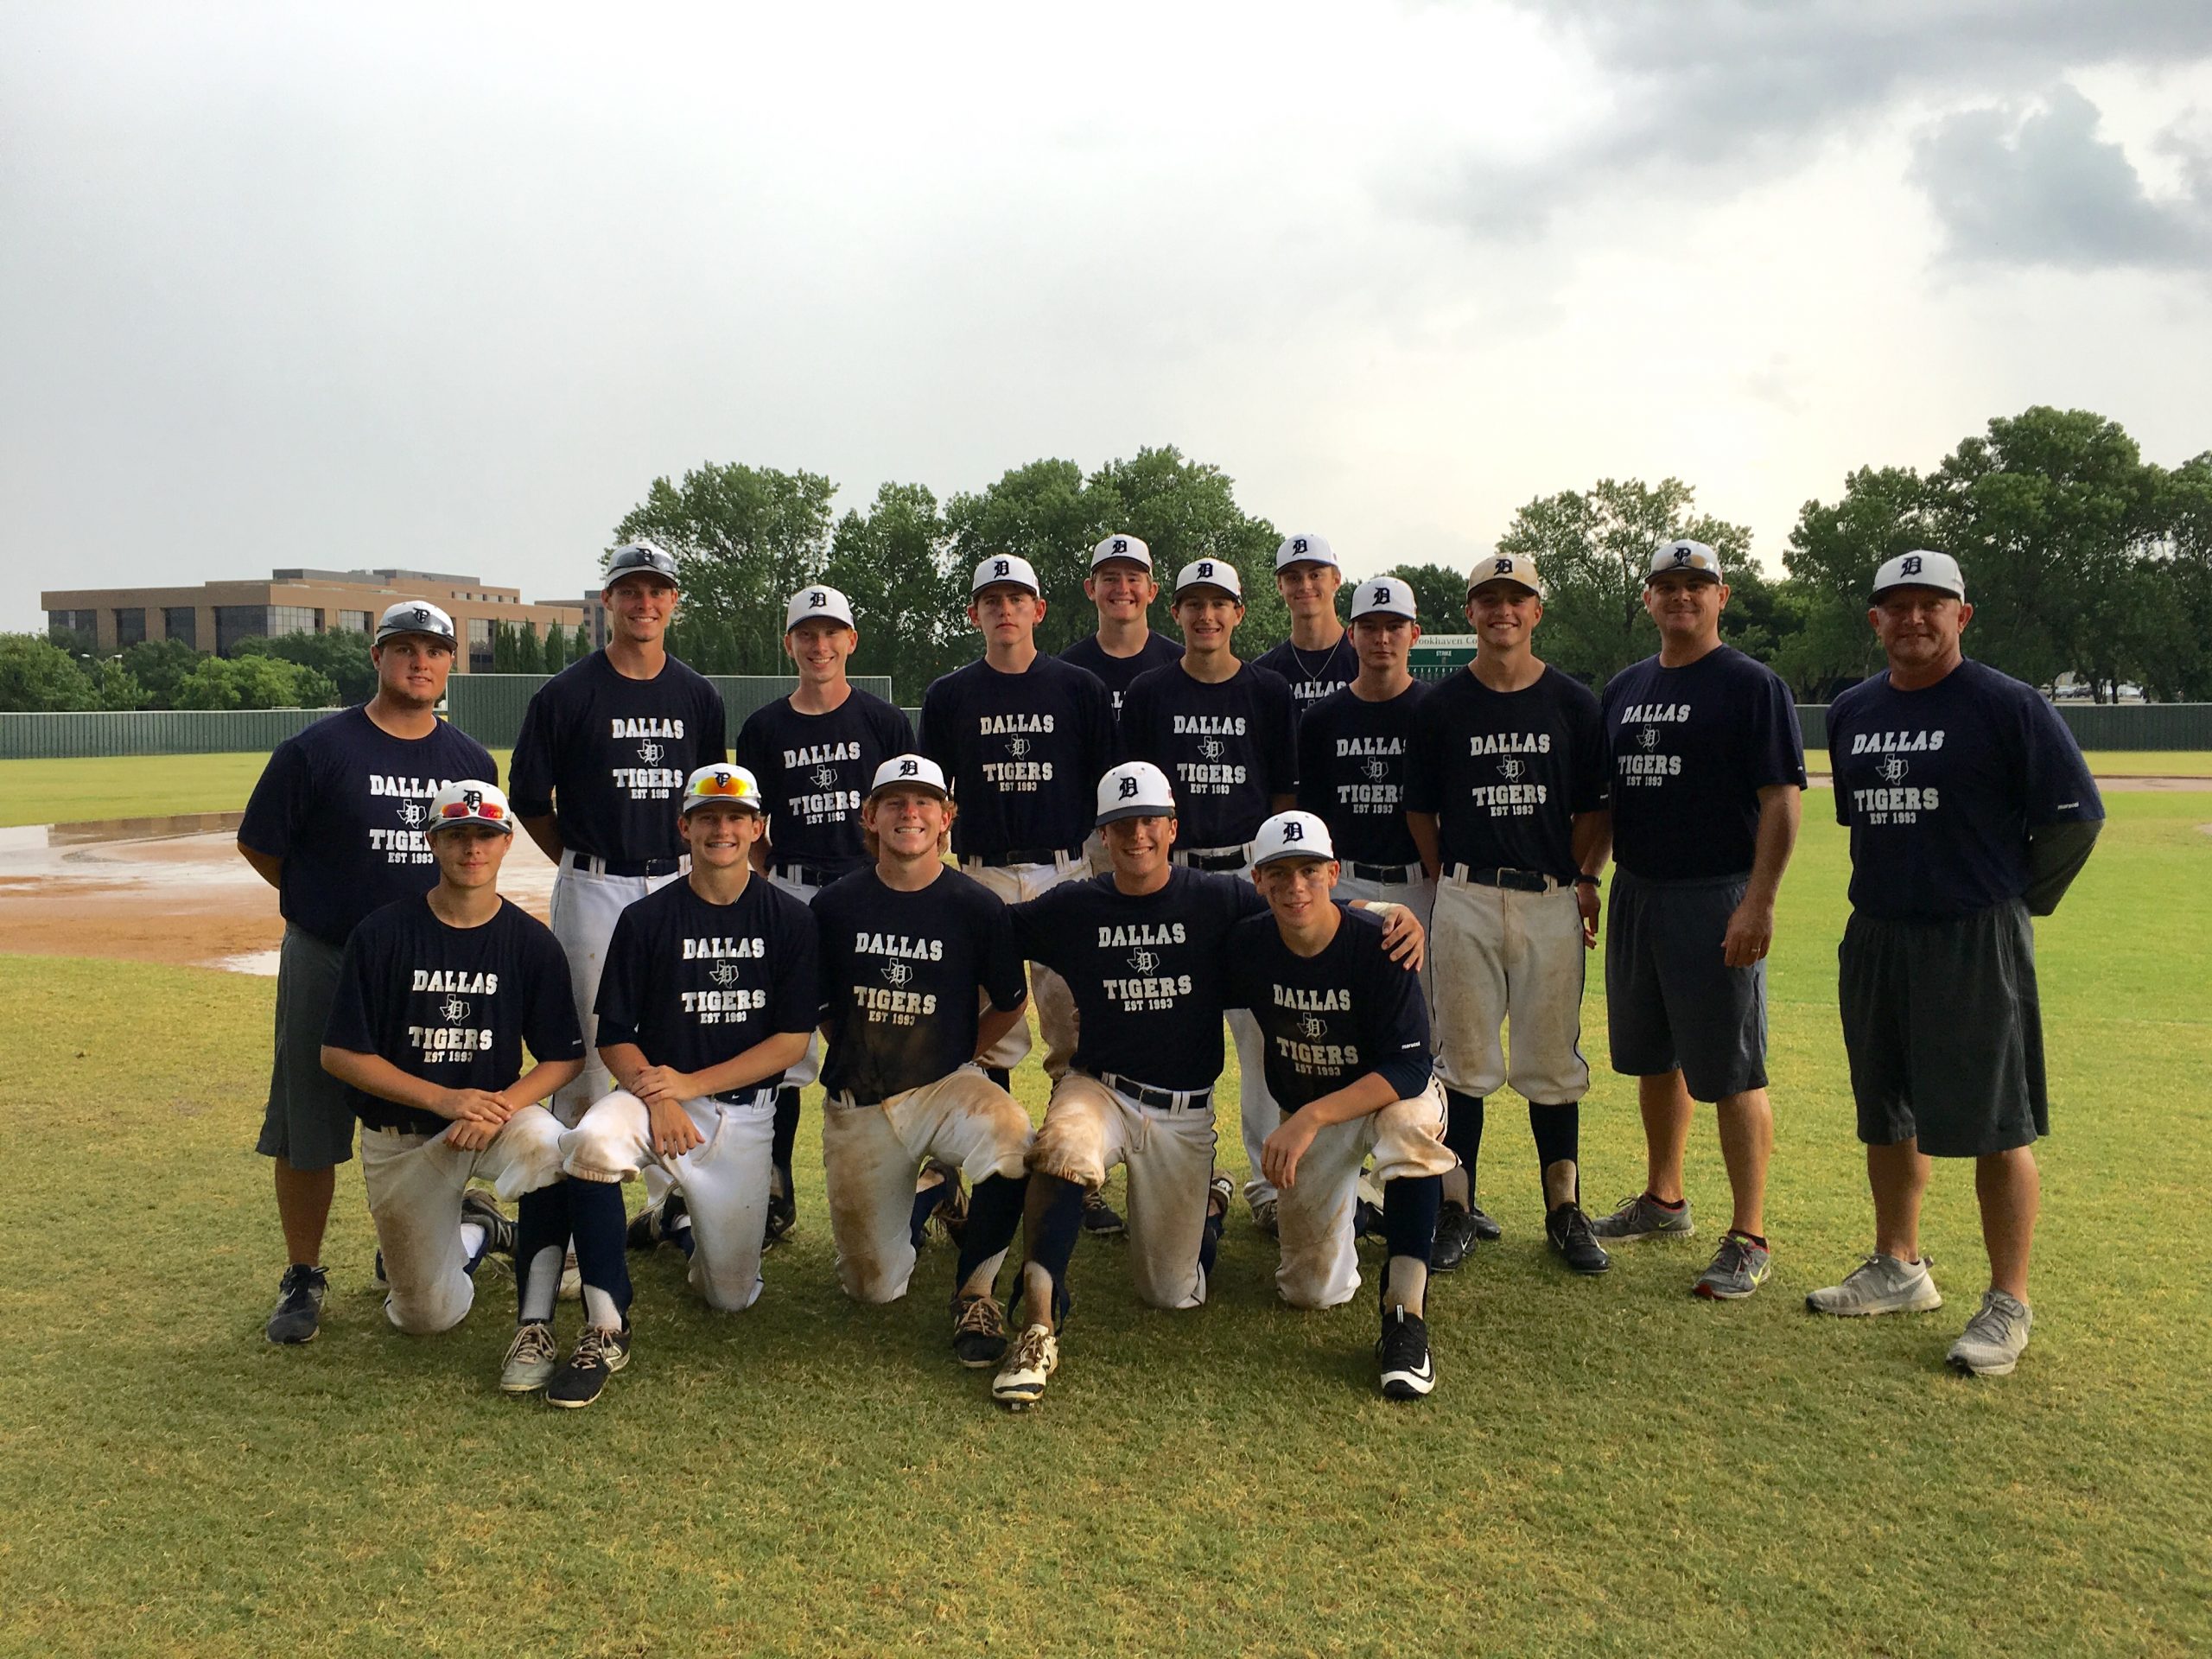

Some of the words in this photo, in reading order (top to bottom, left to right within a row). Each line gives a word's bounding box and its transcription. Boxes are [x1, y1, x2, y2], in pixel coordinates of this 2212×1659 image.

[1111, 540, 1127, 555] D
[1293, 539, 1307, 556] D
[995, 561, 1009, 579] D
[1197, 563, 1213, 580] D
[1494, 559, 1513, 575] D
[1900, 556, 1922, 578] D
[809, 592, 827, 609] D
[1372, 588, 1390, 607] D
[1290, 681, 1346, 699] ALLA
[1621, 704, 1691, 724] DALLAS
[612, 718, 684, 739] DALLAS
[981, 714, 1054, 735] DALLAS
[1173, 715, 1246, 735] DALLAS
[1337, 737, 1406, 757] DALLA
[1471, 733, 1550, 756] DALLAS
[1852, 730, 1945, 754] DALLAS
[784, 741, 861, 769] DALLAS
[1618, 755, 1681, 775] TIGERS
[613, 768, 683, 788] TIGERS
[899, 760, 918, 778] D
[982, 762, 1053, 781] TIGERS
[1177, 763, 1246, 784] TIGERS
[370, 774, 453, 798] DALLA
[1000, 782, 1014, 791] EST
[1017, 782, 1037, 791] 1993
[1119, 777, 1138, 800] D
[1191, 784, 1207, 793] EST
[1627, 777, 1641, 786] EST
[463, 789, 484, 810] D
[631, 789, 648, 799] EST
[789, 791, 861, 816] TIGERS
[1472, 785, 1547, 806] TIGERS
[1854, 787, 1939, 812] TIGERS
[1353, 804, 1369, 813] EST
[1491, 806, 1509, 817] EST
[1513, 804, 1534, 815] 1993
[1870, 813, 1887, 824] EST
[806, 813, 822, 825] EST
[1283, 822, 1303, 844] D
[388, 853, 406, 863] EST
[412, 853, 434, 864] 1993
[1098, 923, 1185, 947] DALLAS
[683, 938, 765, 960] DALLAS
[855, 932, 944, 962] DALLAS
[412, 969, 499, 995] DALLAS
[1103, 975, 1192, 1000] TIGERS
[681, 989, 766, 1013] TIGERS
[854, 986, 938, 1015] TIGERS
[1124, 1000, 1143, 1012] EST
[1148, 998, 1173, 1010] 1993
[1273, 984, 1351, 1011] DALLAS
[700, 1013, 721, 1024] EST
[868, 1010, 888, 1022] EST
[893, 1014, 915, 1027] 1993
[409, 1027, 493, 1050] TIGERS
[423, 1051, 443, 1063] EST
[448, 1051, 473, 1062] 1993
[1276, 1037, 1358, 1065] TIGERS
[1295, 1063, 1312, 1074] EST
[1317, 1065, 1340, 1077] 1993
